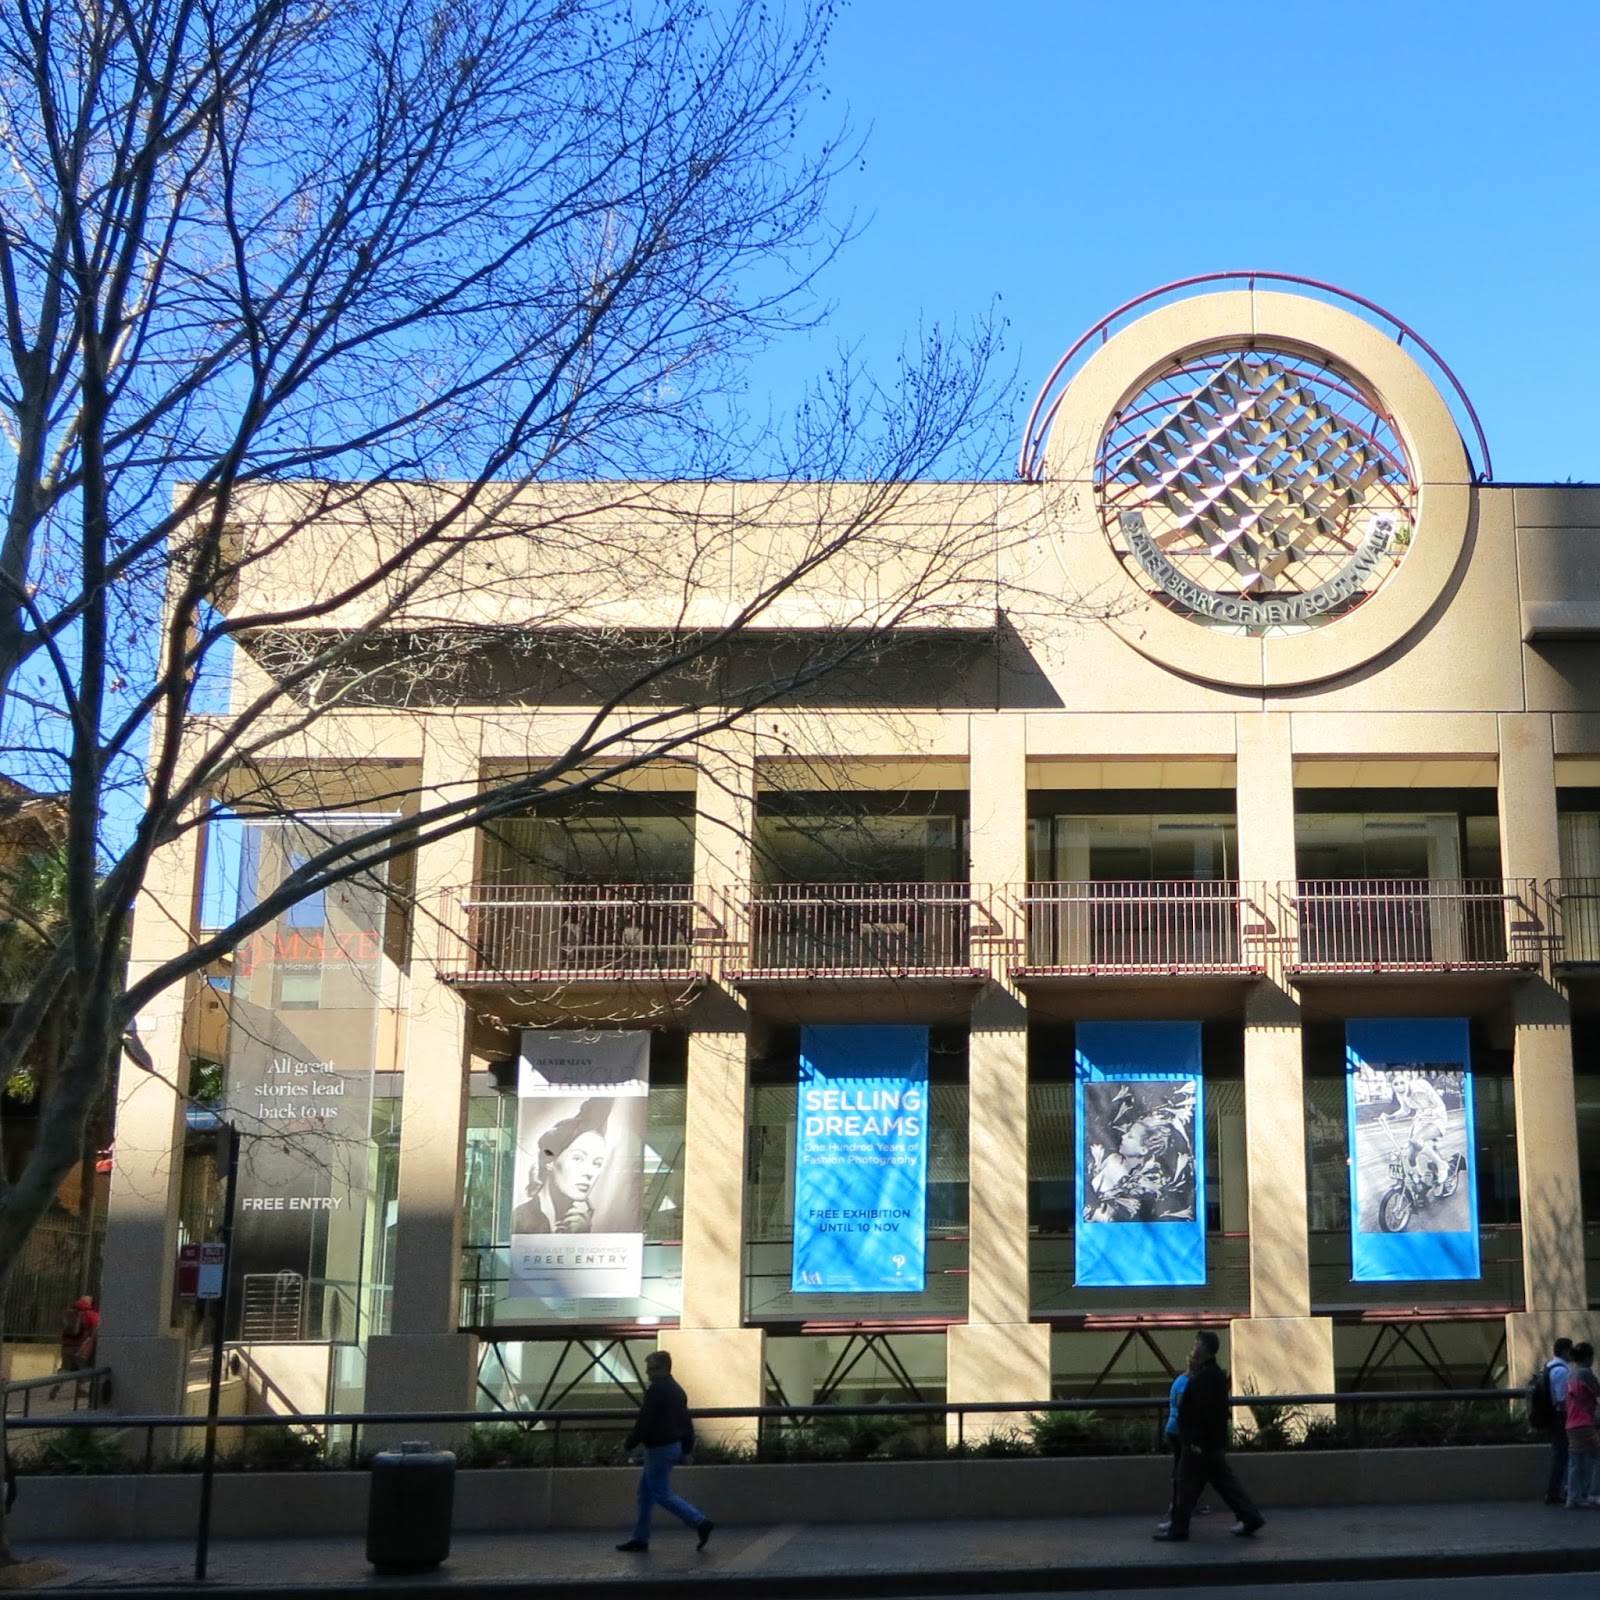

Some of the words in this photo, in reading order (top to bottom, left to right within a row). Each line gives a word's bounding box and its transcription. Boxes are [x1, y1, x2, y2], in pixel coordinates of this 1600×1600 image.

[1156, 566, 1221, 611] LIBRARY
[1224, 603, 1252, 621] OF
[1253, 602, 1301, 622] NEW
[1303, 565, 1362, 614] SOUTH
[1354, 520, 1393, 574] WALES
[237, 931, 380, 977] AMAZE
[267, 1058, 291, 1073] All
[294, 1060, 335, 1076] great
[254, 1082, 309, 1096] stories
[312, 1080, 345, 1096] lead
[806, 1090, 920, 1111] SELLING
[260, 1103, 297, 1118] back
[301, 1105, 317, 1118] to
[320, 1106, 338, 1118] us
[805, 1116, 920, 1136] DREAMS
[804, 1143, 826, 1152] One
[829, 1143, 873, 1152] Hundred
[877, 1143, 905, 1152] Years
[908, 1143, 919, 1152] of
[803, 1155, 844, 1165] Fashion
[848, 1155, 917, 1166] Photography
[241, 1198, 284, 1211] FREE
[289, 1197, 342, 1210] ENTRY
[809, 1209, 840, 1219] FREE
[843, 1209, 911, 1219] EXHIBITION
[819, 1223, 854, 1232] UNTIL
[857, 1223, 870, 1232] 10
[874, 1223, 900, 1232] NOV
[523, 1255, 565, 1264] FREE
[575, 1255, 627, 1264] ENTRY
